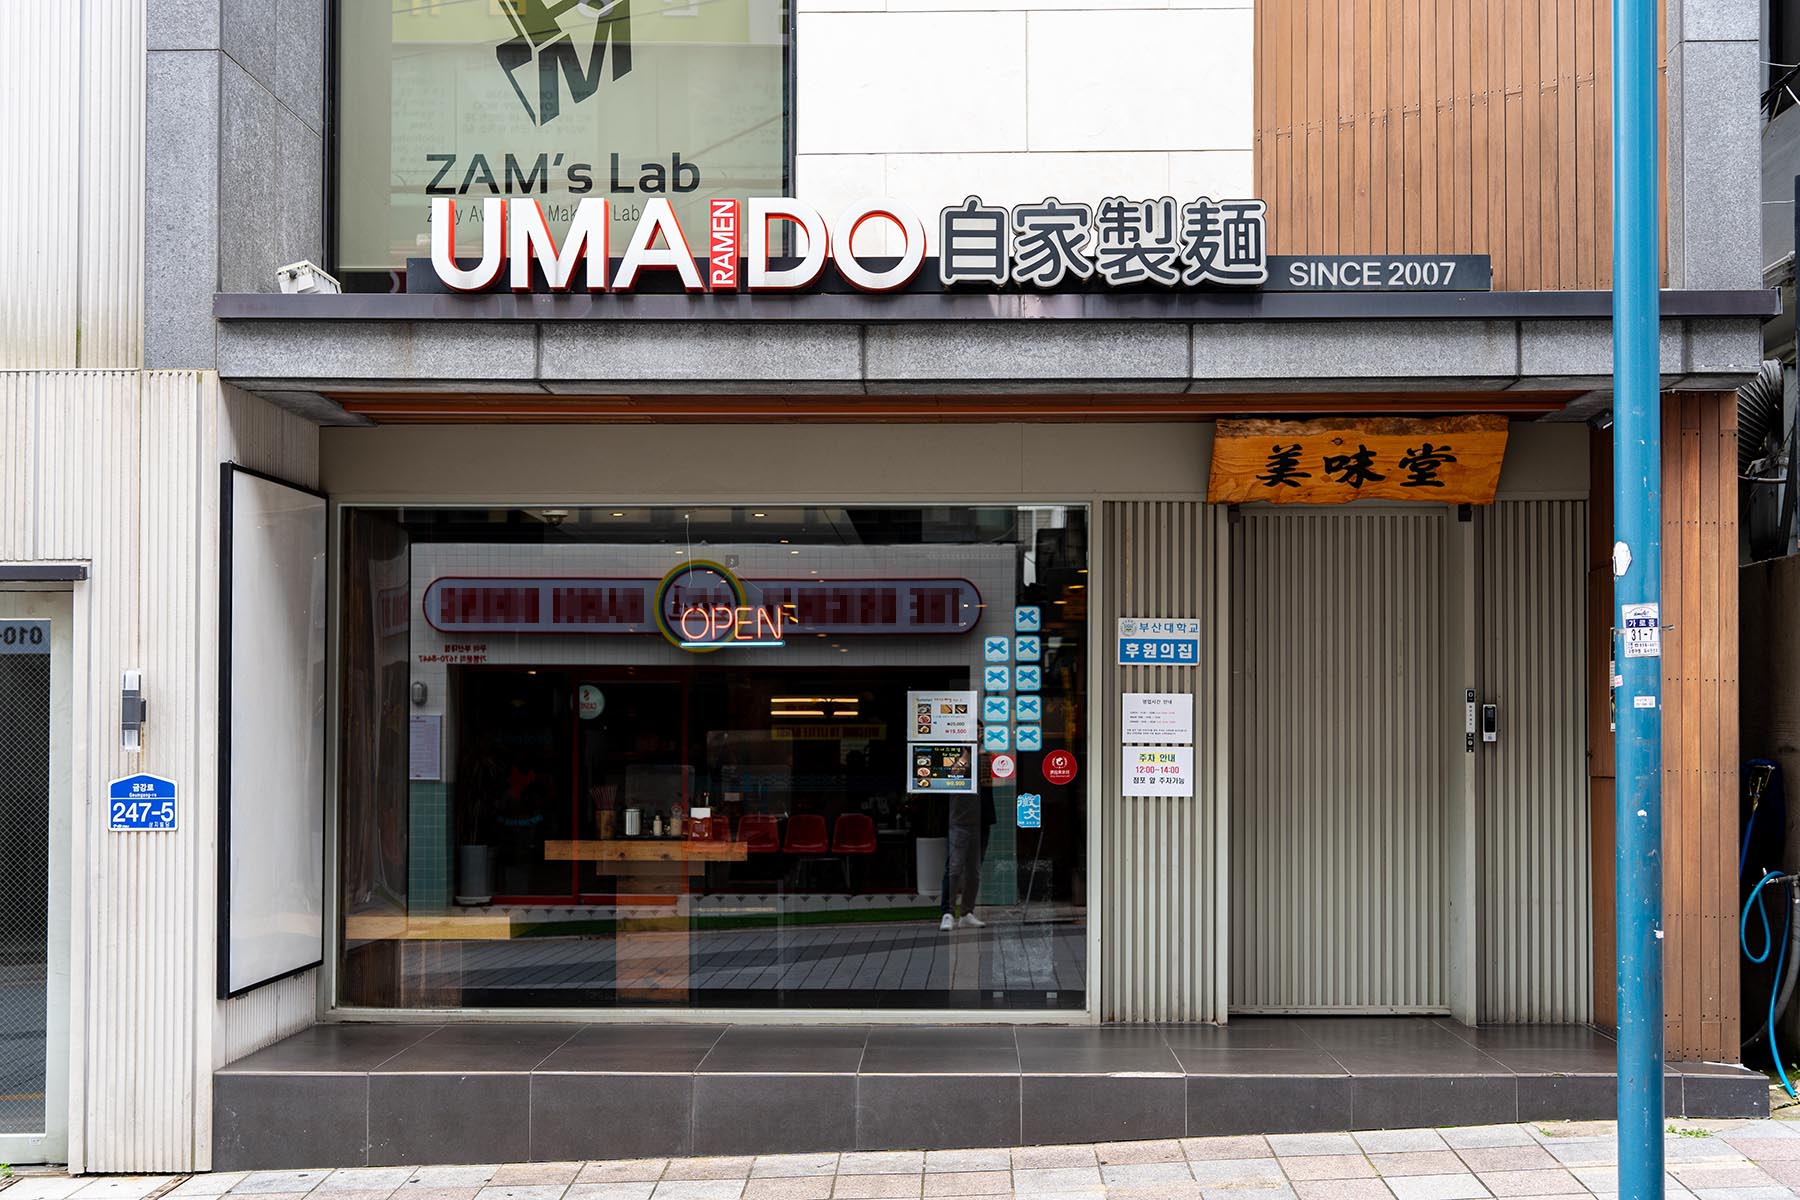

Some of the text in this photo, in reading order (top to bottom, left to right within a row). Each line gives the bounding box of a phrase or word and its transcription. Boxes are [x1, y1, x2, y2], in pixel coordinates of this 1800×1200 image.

[610, 152, 701, 194] Lab
[712, 200, 735, 286] RAMEN
[1289, 261, 1456, 287] SINCE 2007
[1256, 443, 1457, 489] 美味堂
[681, 605, 782, 640] OPEN
[1139, 622, 1199, 634] 부산대학교
[1125, 642, 1193, 659] 후원의집
[1139, 753, 1176, 763] 주차 안내
[132, 783, 154, 792] 금강로
[1159, 776, 1185, 784] 주차가능
[112, 801, 174, 823] 247-5
